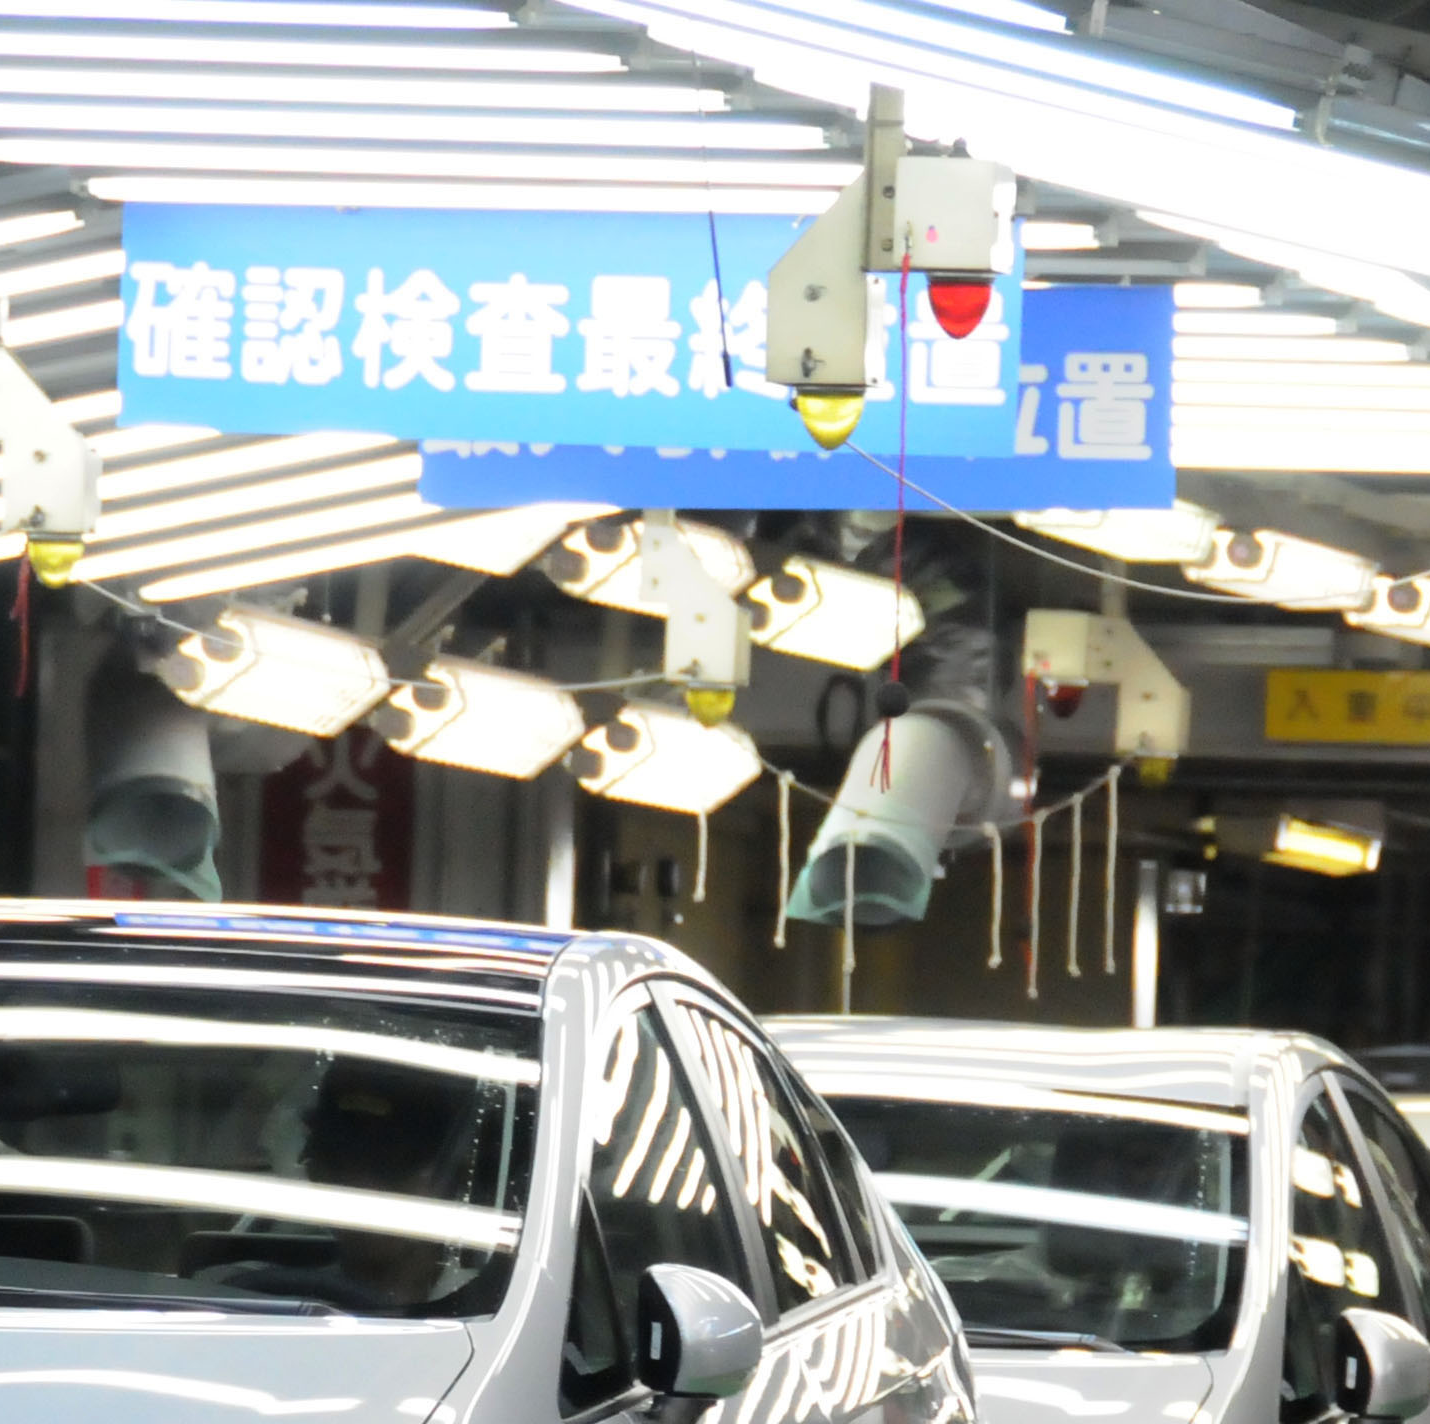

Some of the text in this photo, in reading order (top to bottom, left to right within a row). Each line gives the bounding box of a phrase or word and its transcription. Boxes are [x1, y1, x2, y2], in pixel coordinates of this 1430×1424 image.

[126, 259, 1008, 406] 確認検査最終置
